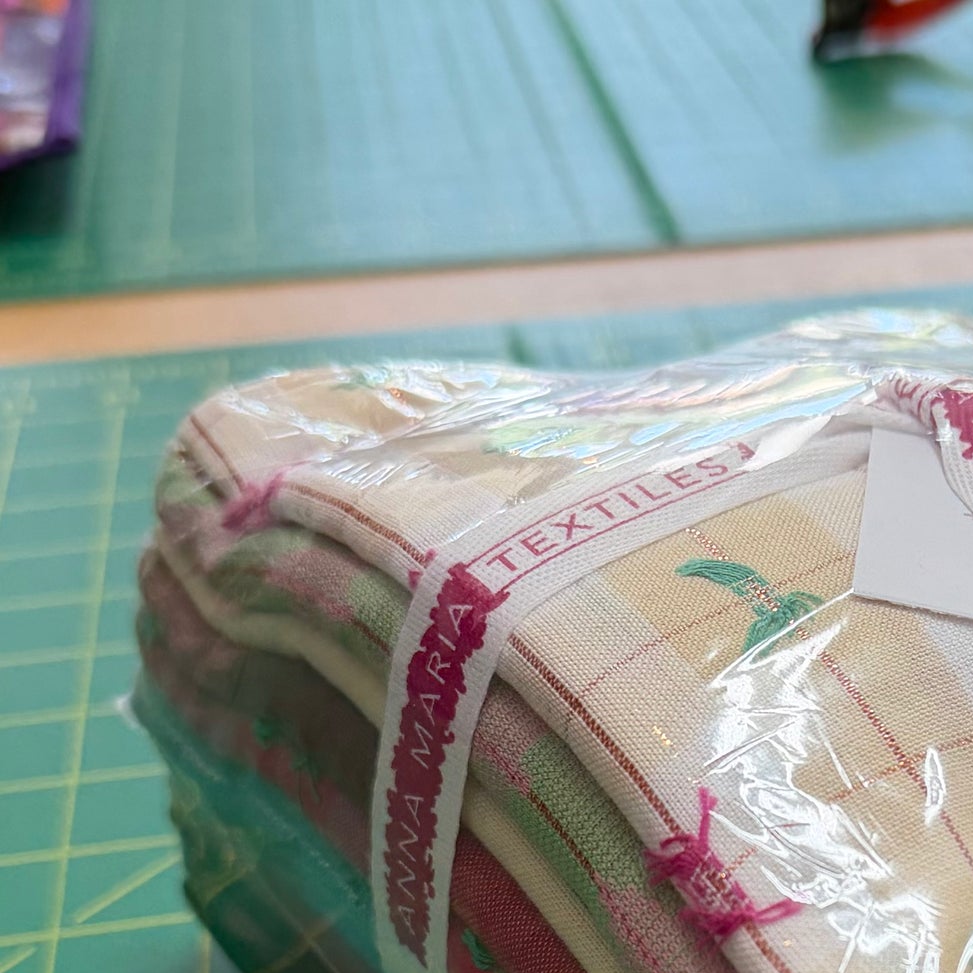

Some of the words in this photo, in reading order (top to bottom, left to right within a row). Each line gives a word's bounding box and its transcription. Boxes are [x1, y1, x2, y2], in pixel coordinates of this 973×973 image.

[486, 456, 729, 572] TEXTILES
[410, 604, 474, 770] MARIA
[397, 794, 425, 935] ANNA
